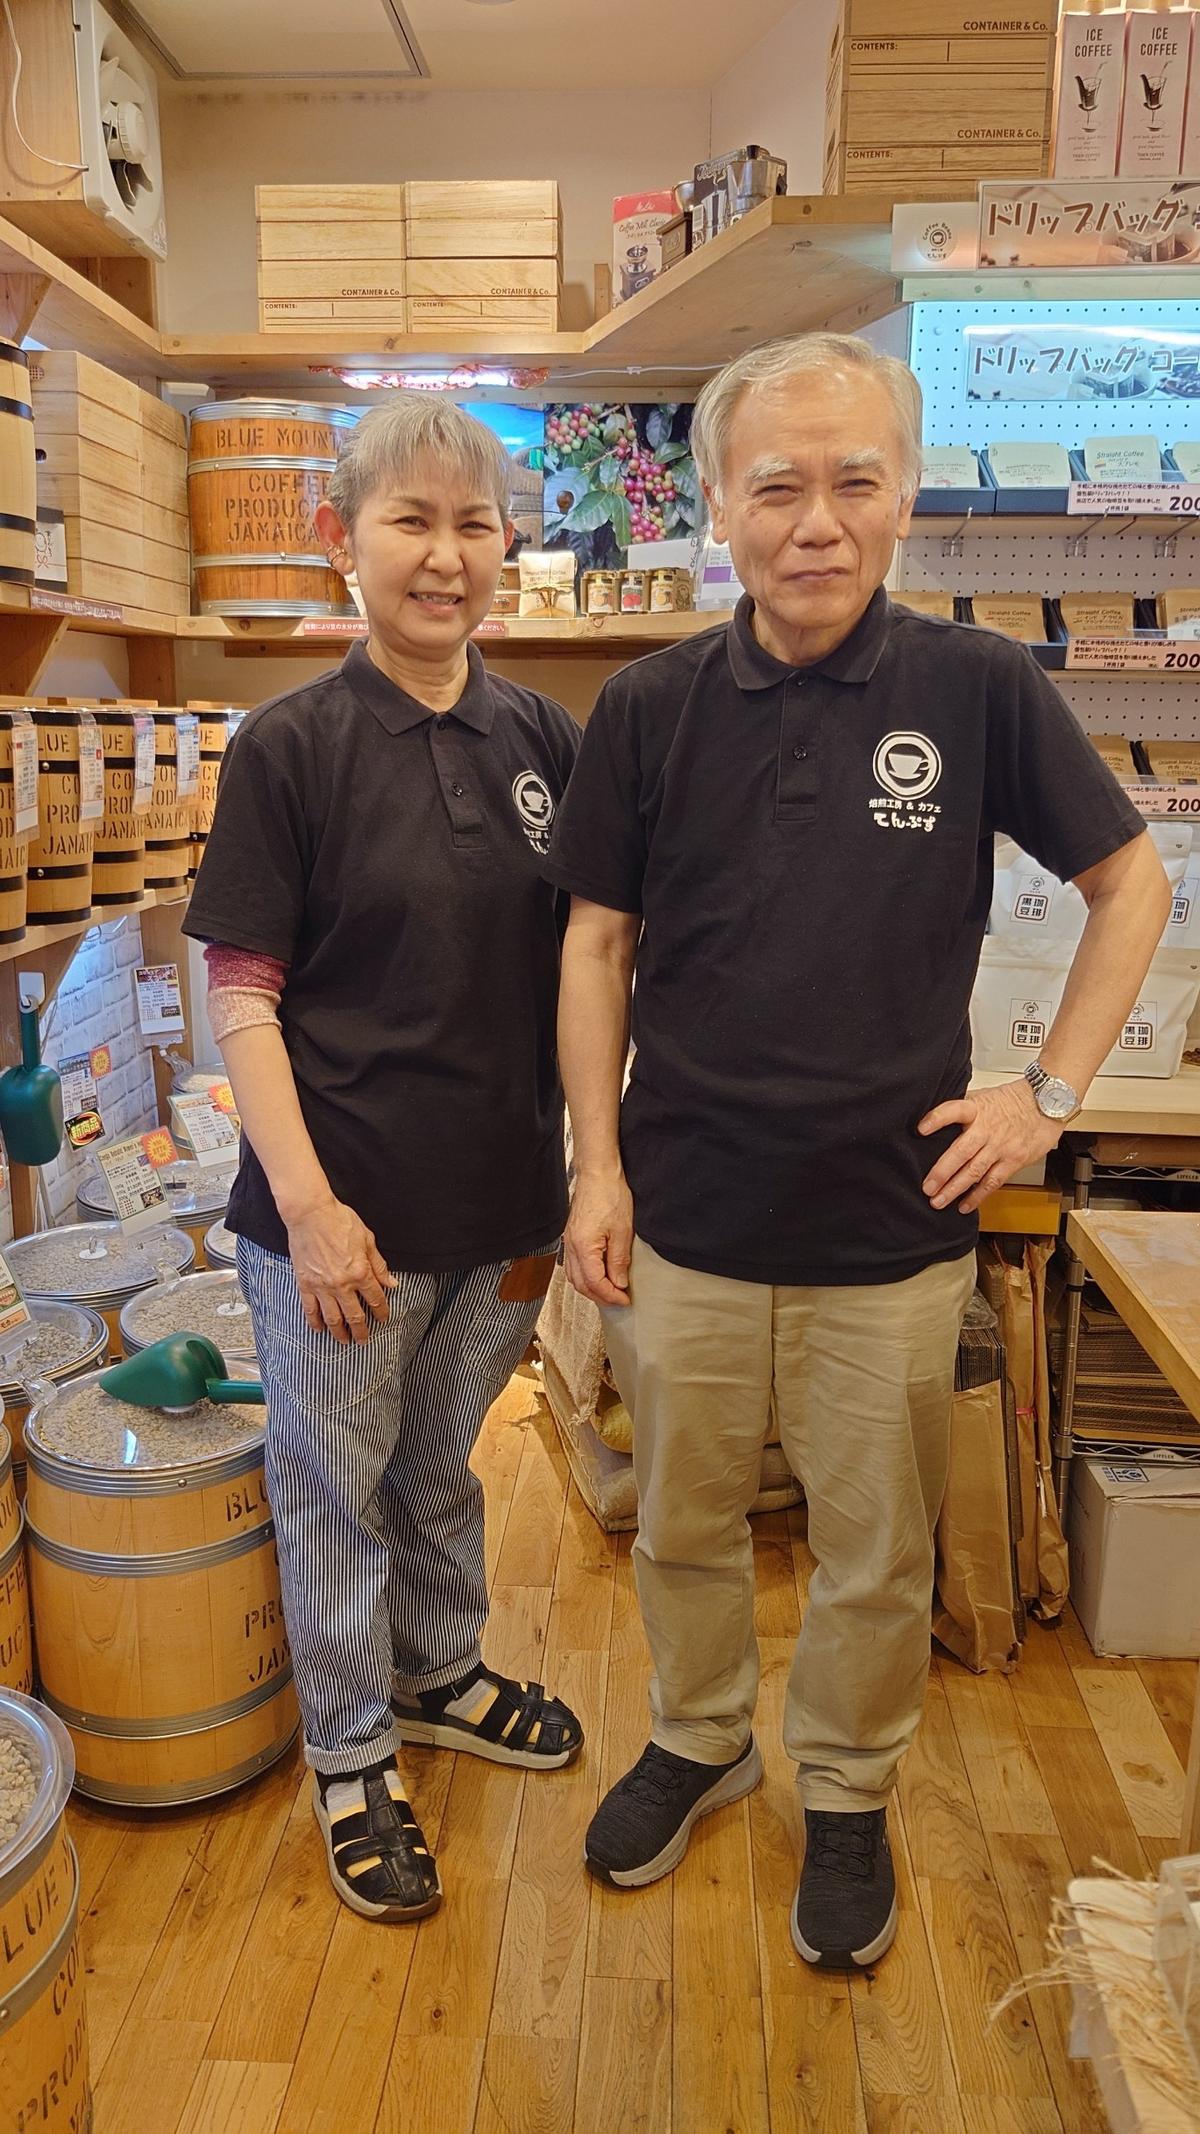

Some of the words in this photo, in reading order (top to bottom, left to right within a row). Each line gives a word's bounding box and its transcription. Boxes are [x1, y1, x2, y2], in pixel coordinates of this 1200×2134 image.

[963, 21, 1022, 31] CONTAINER
[1024, 22, 1030, 31] &
[1032, 21, 1049, 31] Co.
[1086, 29, 1103, 41] ICE
[1152, 27, 1169, 40] ICE
[851, 42, 898, 50] CONTENTS:
[1075, 44, 1113, 57] COFFEE
[1140, 43, 1178, 56] COFFEE
[957, 129, 1016, 139] CONTAINER
[1017, 130, 1025, 138] &
[1026, 129, 1041, 139] Co.
[847, 150, 893, 159] CONTENTS:
[988, 198, 1185, 236] ドリップバッグ
[972, 345, 1141, 376] ドリップバッグ
[1151, 350, 1200, 373] コー
[217, 427, 265, 449] BLUE
[277, 427, 339, 451] MOUNT
[225, 498, 318, 519] PRODUC
[229, 522, 321, 543] JAMAICA
[1164, 653, 1200, 668] 200
[868, 799, 903, 810] 焙煎工房
[906, 801, 914, 810] &
[918, 802, 942, 813] カフェ
[1166, 798, 1200, 812] 200
